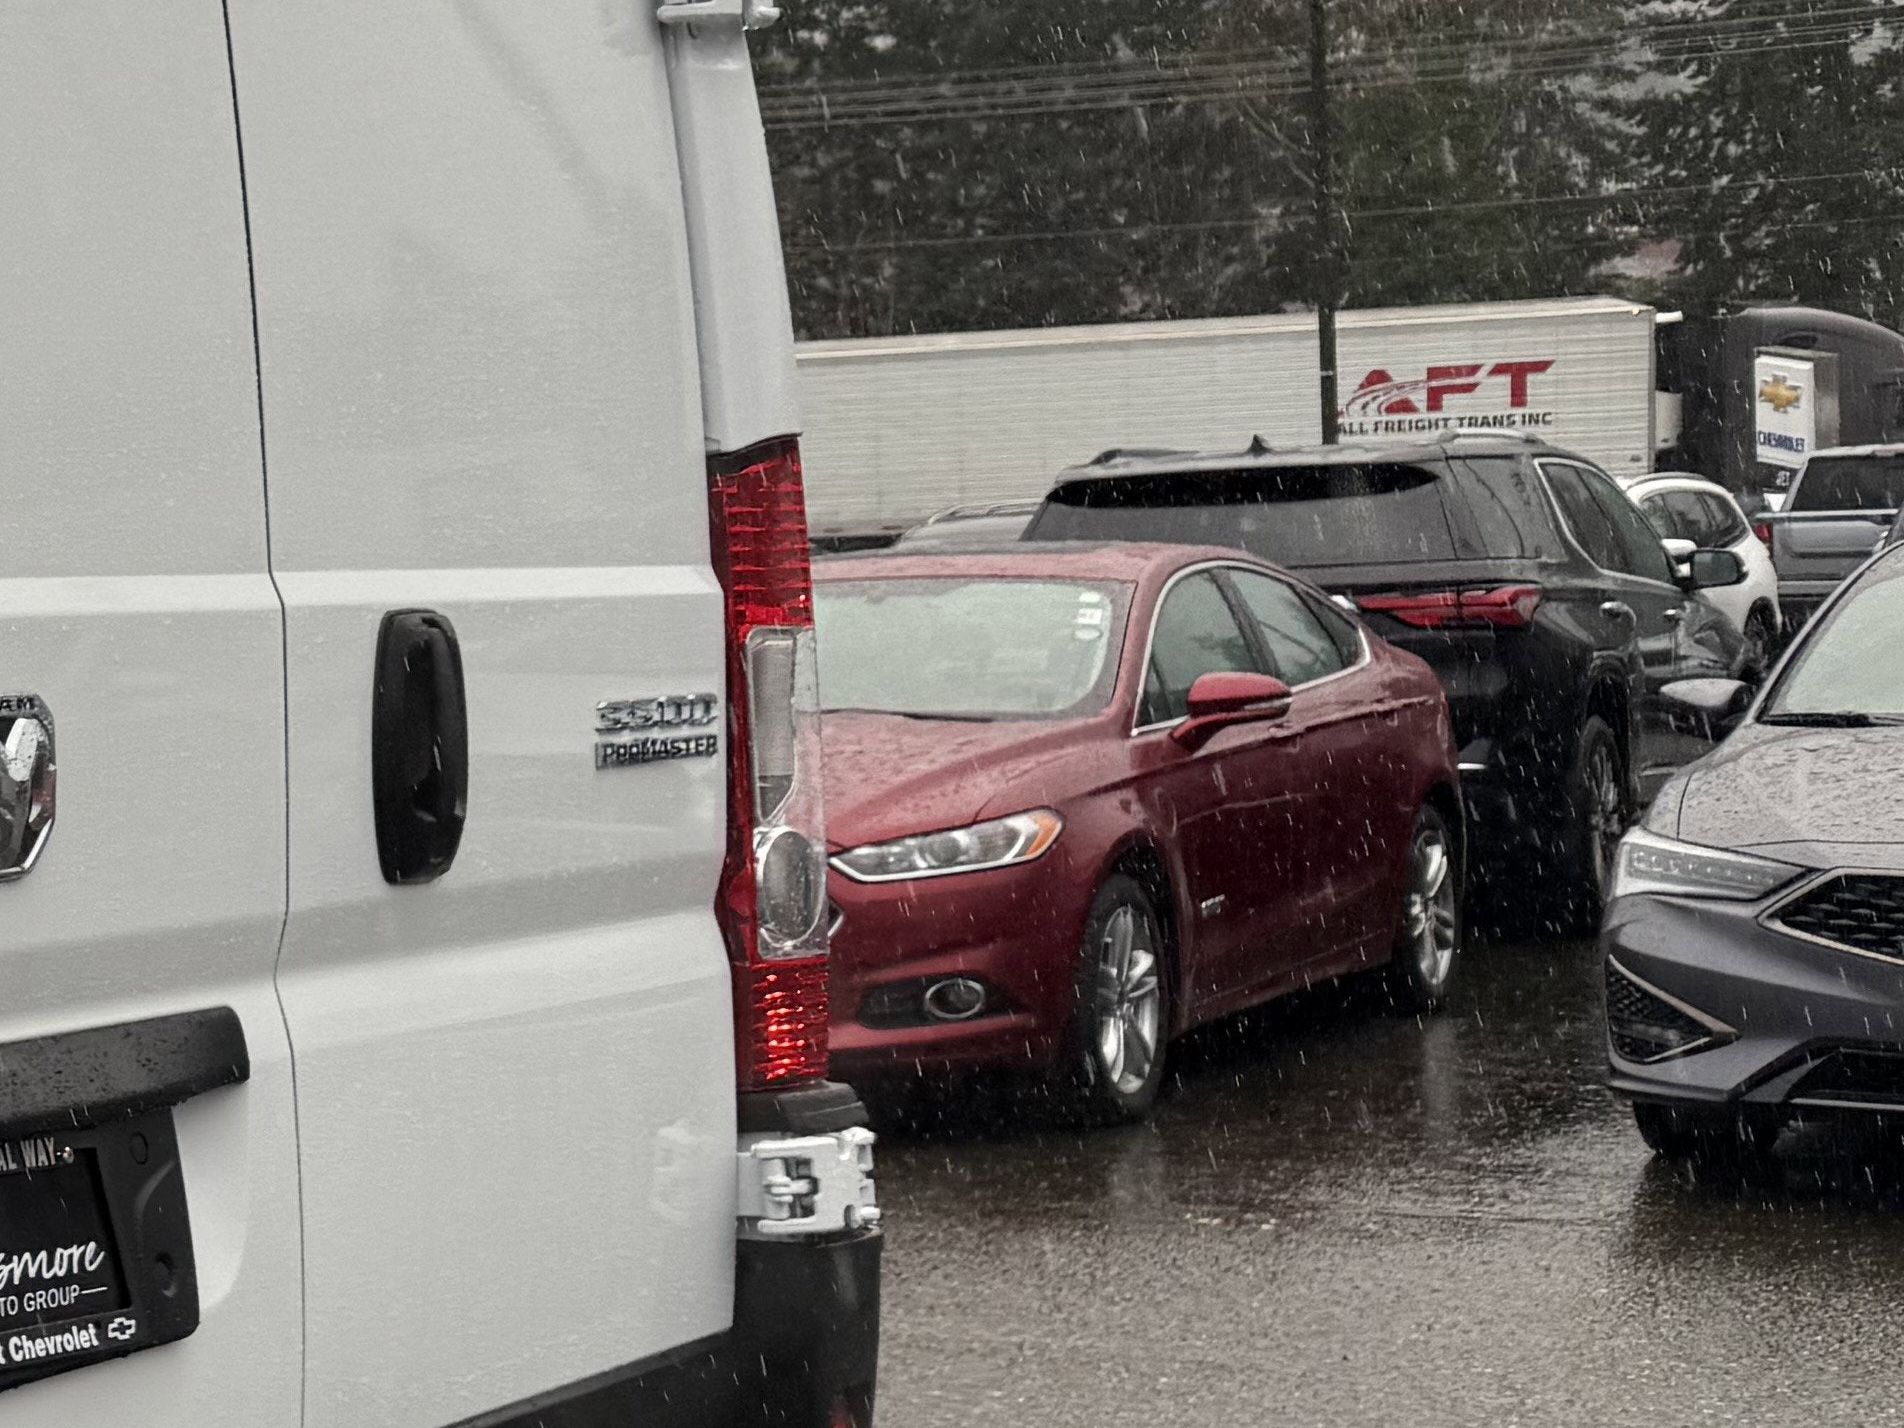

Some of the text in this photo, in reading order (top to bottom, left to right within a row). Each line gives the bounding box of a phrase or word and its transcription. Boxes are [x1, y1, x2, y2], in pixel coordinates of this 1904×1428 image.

[1338, 360, 1556, 414] AFT
[1373, 418, 1451, 434] FREIGHT
[1456, 414, 1517, 429] TRANS
[1521, 412, 1553, 427] INC
[598, 735, 718, 768] PROMASTER
[20, 1136, 57, 1168] WAY
[23, 1284, 80, 1312] GROUP
[8, 1323, 99, 1363] Chevrolet
